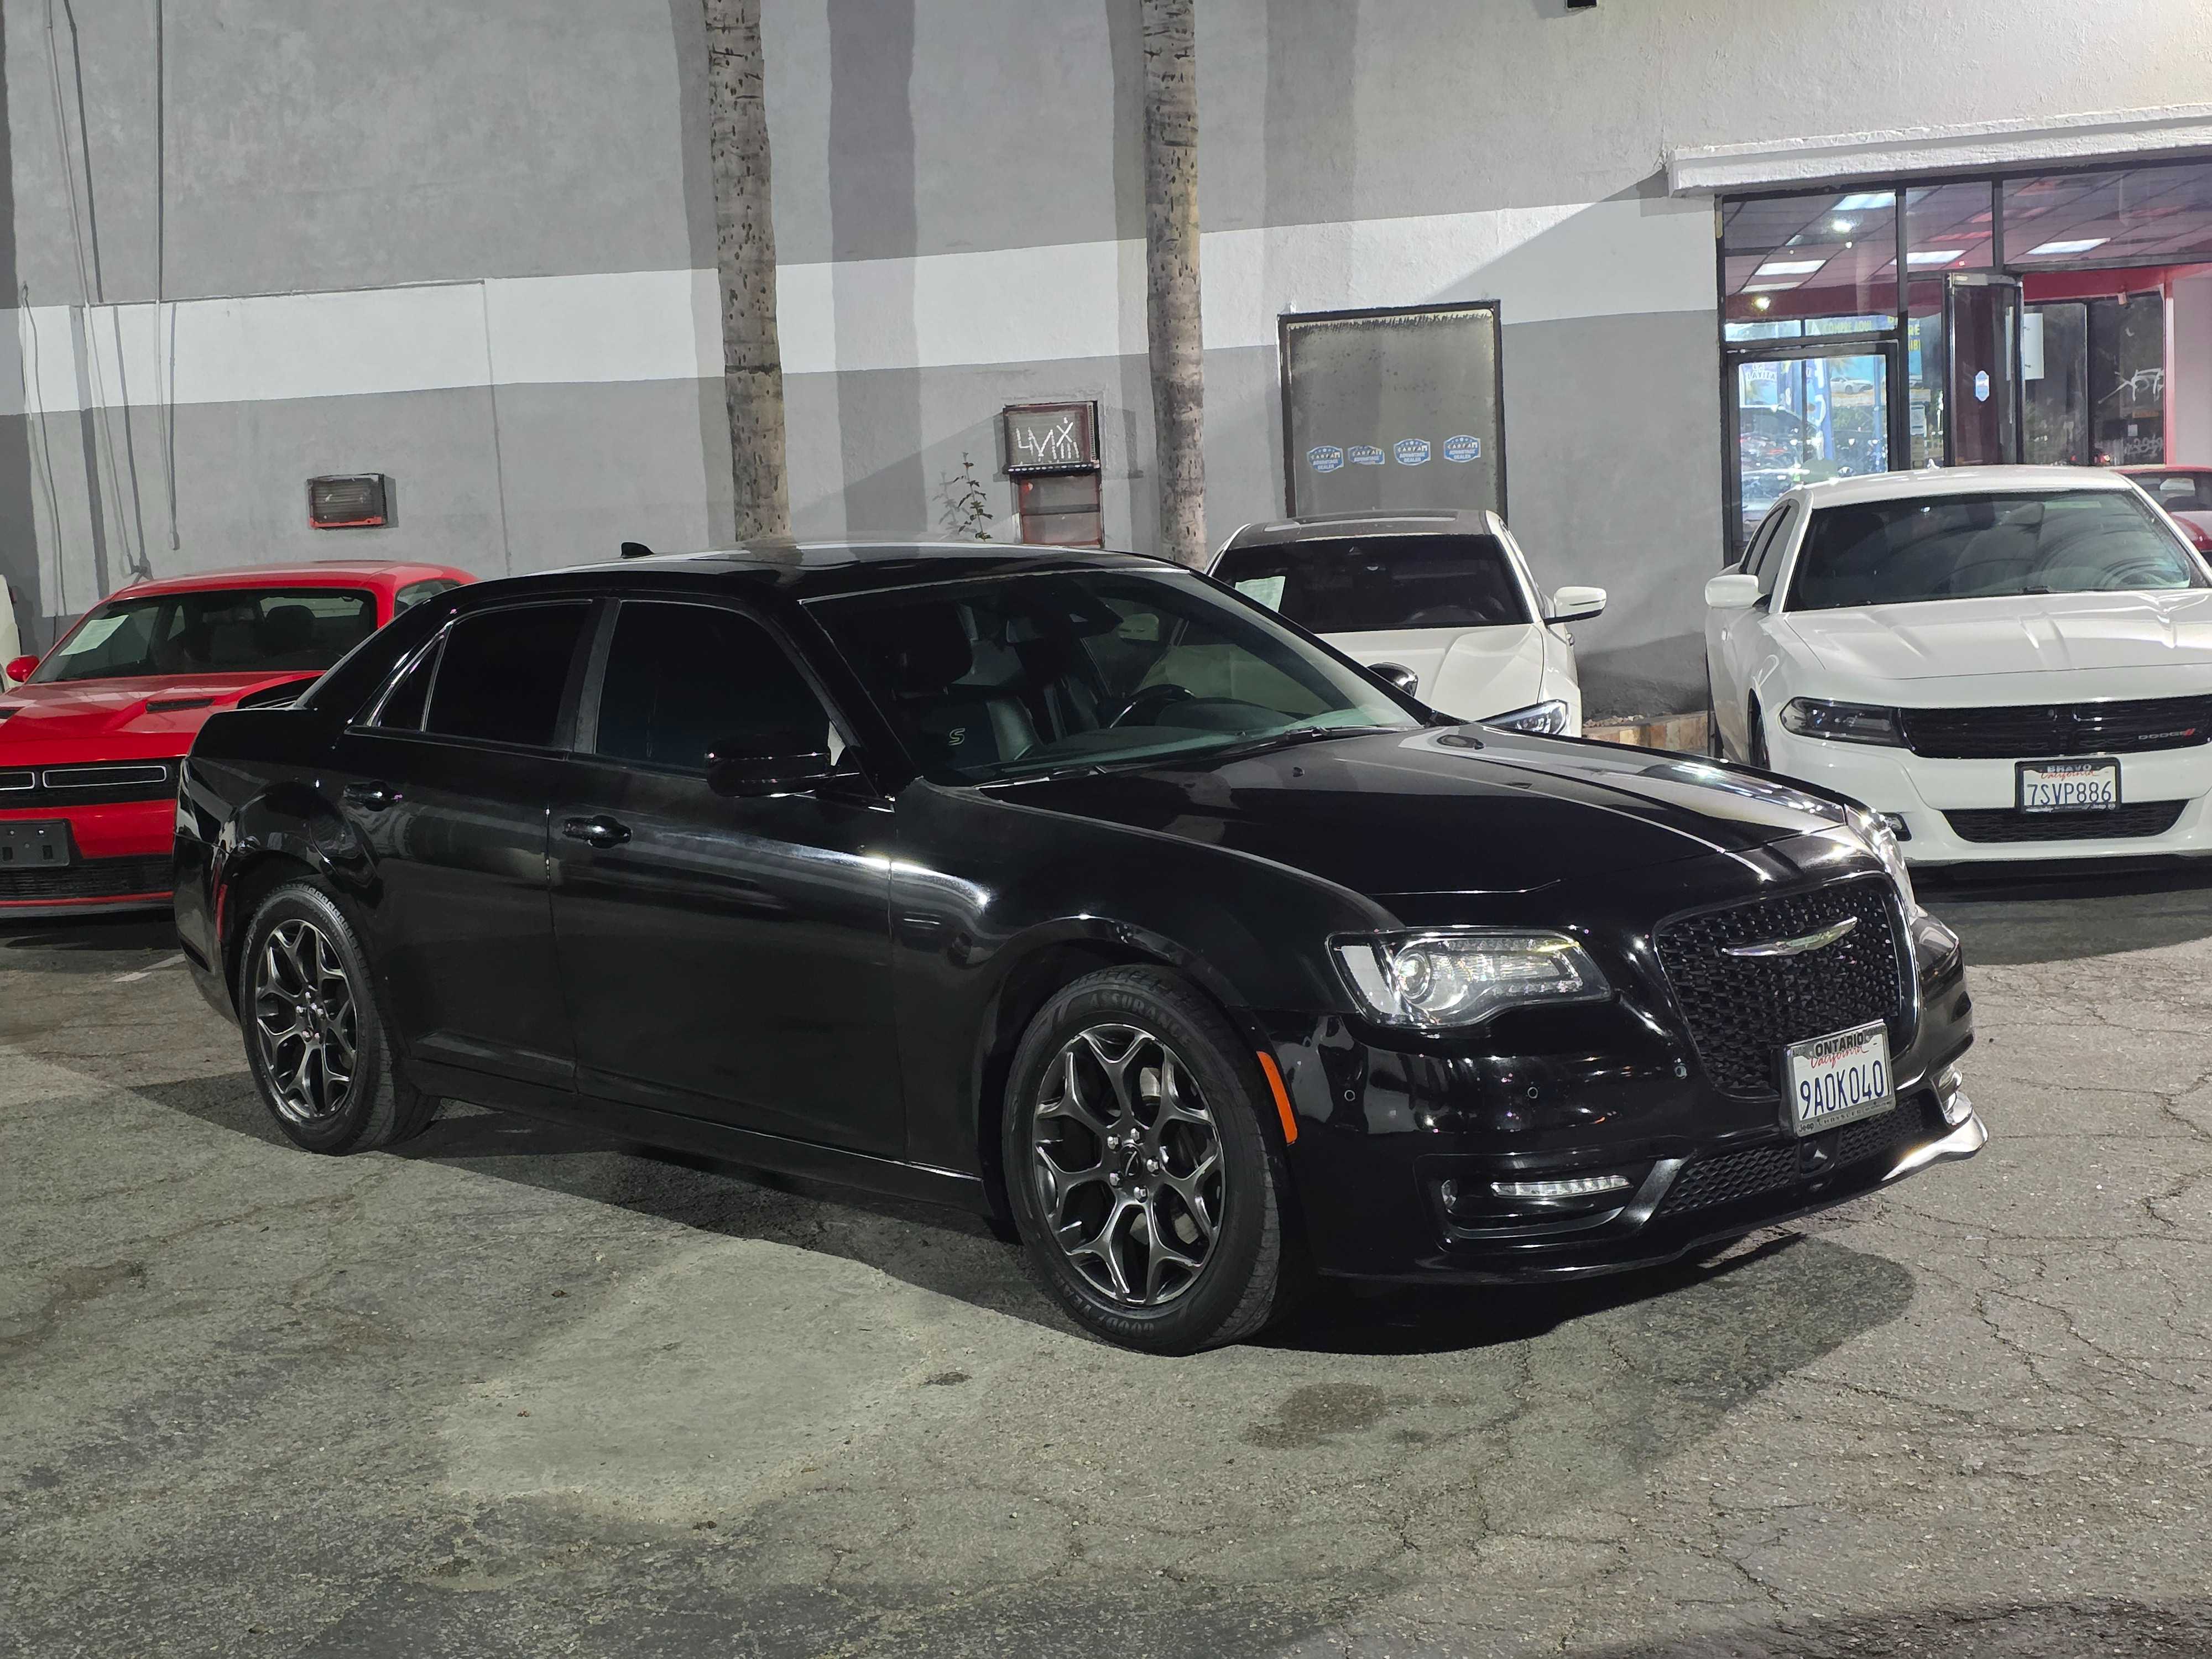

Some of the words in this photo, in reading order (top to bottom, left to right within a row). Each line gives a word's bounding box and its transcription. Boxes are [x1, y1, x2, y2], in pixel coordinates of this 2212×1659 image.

[948, 727, 966, 745] S
[2138, 731, 2186, 740] DODGE
[2047, 764, 2092, 773] BRAVO
[2027, 780, 2111, 806] 7SVP886
[1088, 990, 1193, 1047] ASSURANCE
[1815, 1032, 1864, 1057] ONTARIO
[1799, 1060, 1885, 1120] 9AOK040
[1818, 1109, 1862, 1126] CHRYSLER
[1798, 1122, 1814, 1133] Jeep
